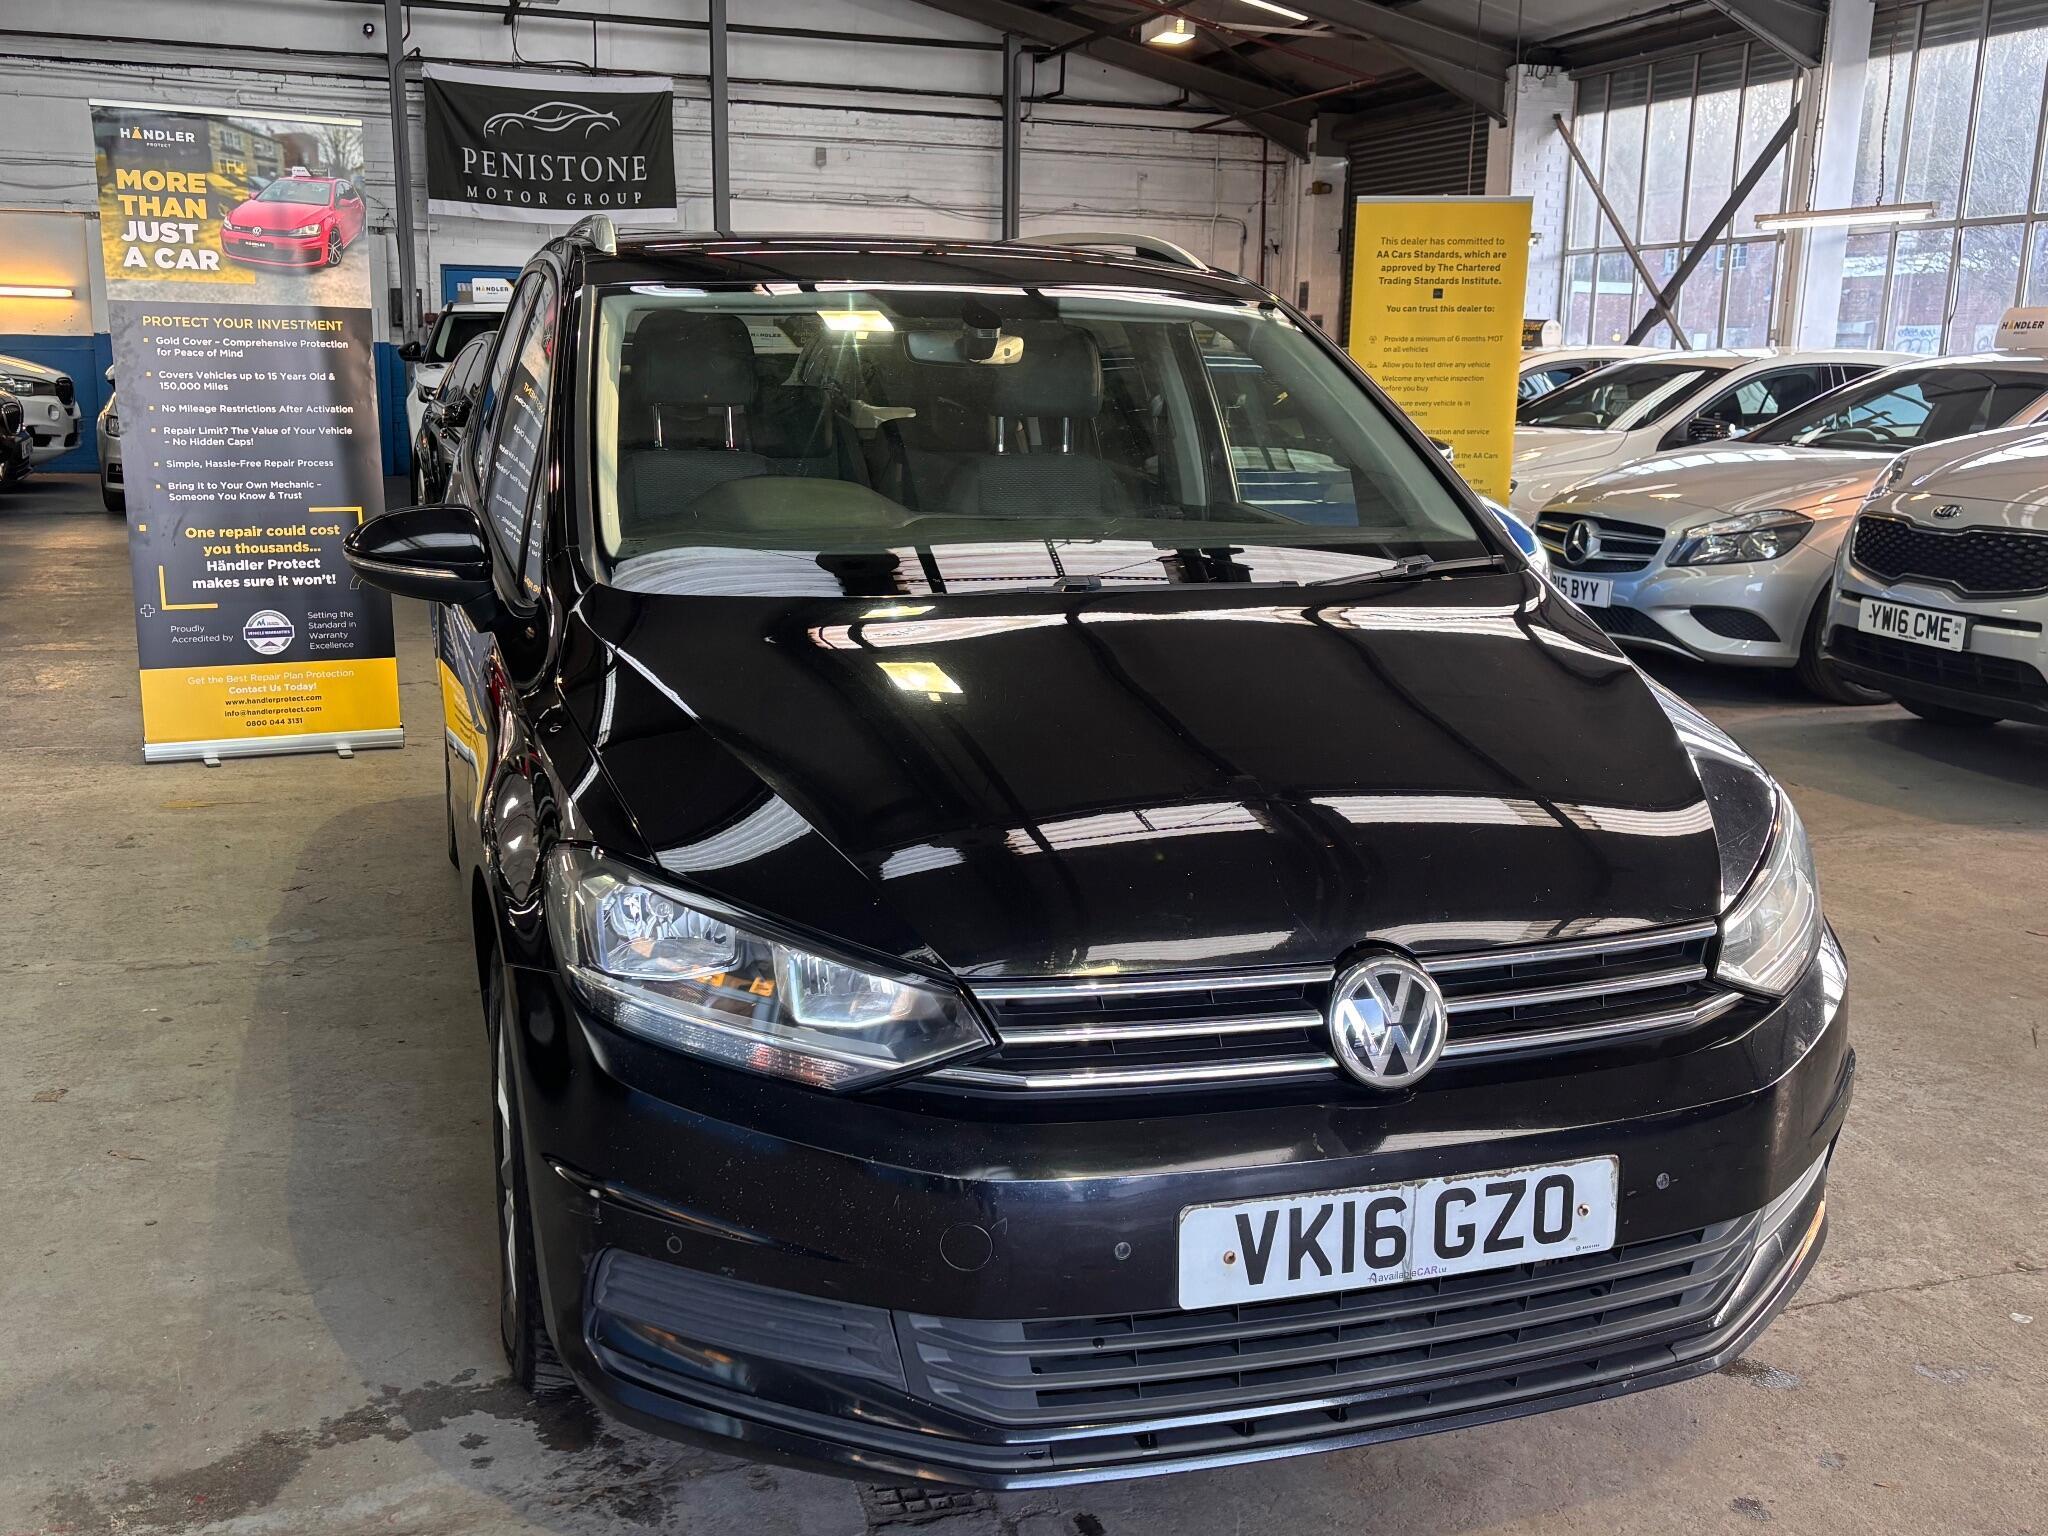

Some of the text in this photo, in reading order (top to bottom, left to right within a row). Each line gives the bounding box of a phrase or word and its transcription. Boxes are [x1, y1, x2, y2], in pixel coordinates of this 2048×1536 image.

[462, 147, 647, 183] PENISTONE
[116, 168, 206, 194] MORE
[467, 185, 642, 205] MOTOR GROUP
[118, 194, 207, 220] THAN
[121, 221, 198, 244] JUST
[1381, 237, 1398, 245] This
[1401, 237, 1427, 245] dealer
[1430, 237, 1444, 245] has
[1447, 237, 1494, 245] committed
[124, 246, 220, 270] A CAR
[1377, 250, 1389, 258] AA
[1392, 250, 1411, 258] Cars
[1414, 250, 1462, 259] Standards,
[1464, 250, 1490, 258] which
[1381, 264, 1422, 273] approved
[1425, 264, 1436, 273] by
[1379, 277, 1411, 286] Trading
[142, 315, 344, 331] PROTECT YOUR INVESTMENT
[156, 336, 349, 349] Gold Cover Comprehensive Protection
[156, 348, 244, 358] for Peace of Mind
[158, 371, 194, 379] Covers
[196, 371, 237, 380] Vehicles
[254, 372, 265, 380] to
[268, 372, 278, 380] 15
[280, 372, 307, 381] Years
[309, 372, 326, 381] Old
[328, 372, 336, 381] &
[160, 382, 228, 391] 150,000 Miles
[161, 404, 354, 414] No Mileage Restrictions After Activation
[164, 427, 353, 436] Repair Limit? The Value of Your Vehicle
[172, 438, 254, 448] No Hidden Caps!
[166, 459, 334, 469] Simple, Hassle-Free Repair Process
[168, 480, 314, 491] Bring to Your Own Mechanic
[169, 491, 302, 501] Someone You Know & Trust
[185, 524, 340, 539] One repair could cost
[204, 542, 321, 557] you thousands...
[206, 558, 321, 572] Händler Protect
[192, 574, 336, 588] makes sure it won't!
[1571, 579, 1599, 601] BYY
[308, 611, 337, 620] Setting
[170, 624, 205, 633] Proudly
[308, 621, 346, 629] Standard
[1872, 604, 1952, 643] YW16 CME
[172, 634, 233, 644] Accredited by
[309, 631, 348, 640] Warranty
[310, 641, 354, 649] Excellence
[188, 676, 204, 685] Get
[227, 675, 247, 683] Best
[250, 673, 280, 682] Repair
[284, 672, 303, 680] Plan
[306, 670, 354, 678] Protection
[229, 686, 266, 694] Contact
[284, 683, 316, 692] Today!
[225, 695, 322, 706] www.handlerprotect.com
[225, 706, 322, 717] info@handlerprotect.com
[1235, 1173, 1574, 1286] VK16 GZO
[1378, 1266, 1438, 1282] availableCAR
